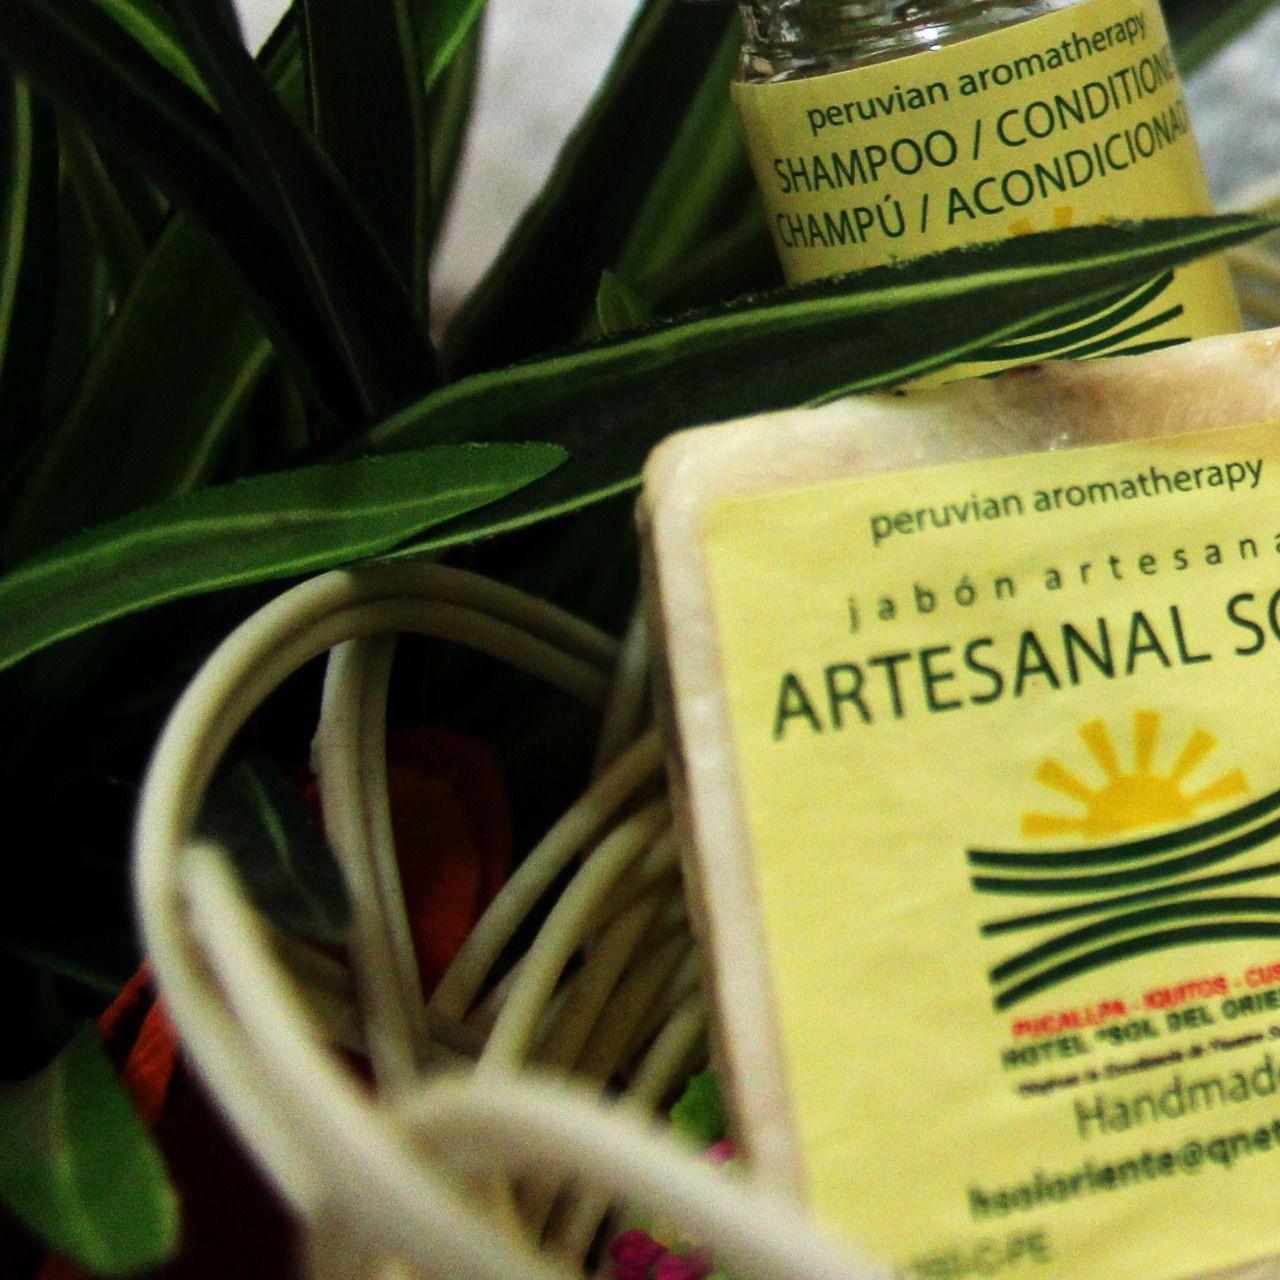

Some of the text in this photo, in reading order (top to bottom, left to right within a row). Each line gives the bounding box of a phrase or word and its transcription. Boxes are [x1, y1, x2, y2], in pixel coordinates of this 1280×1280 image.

[807, 11, 1147, 136] peruvian aromatherapy
[774, 129, 958, 195] SHAMPOO
[971, 119, 983, 161] /
[775, 194, 906, 250] CHAMPÚ
[919, 193, 930, 233] /
[870, 455, 1265, 547] peruvian aromatherapy
[848, 573, 1015, 632] jabón
[774, 604, 1210, 740] ARTESANAL
[1166, 1006, 1215, 1032] DEL
